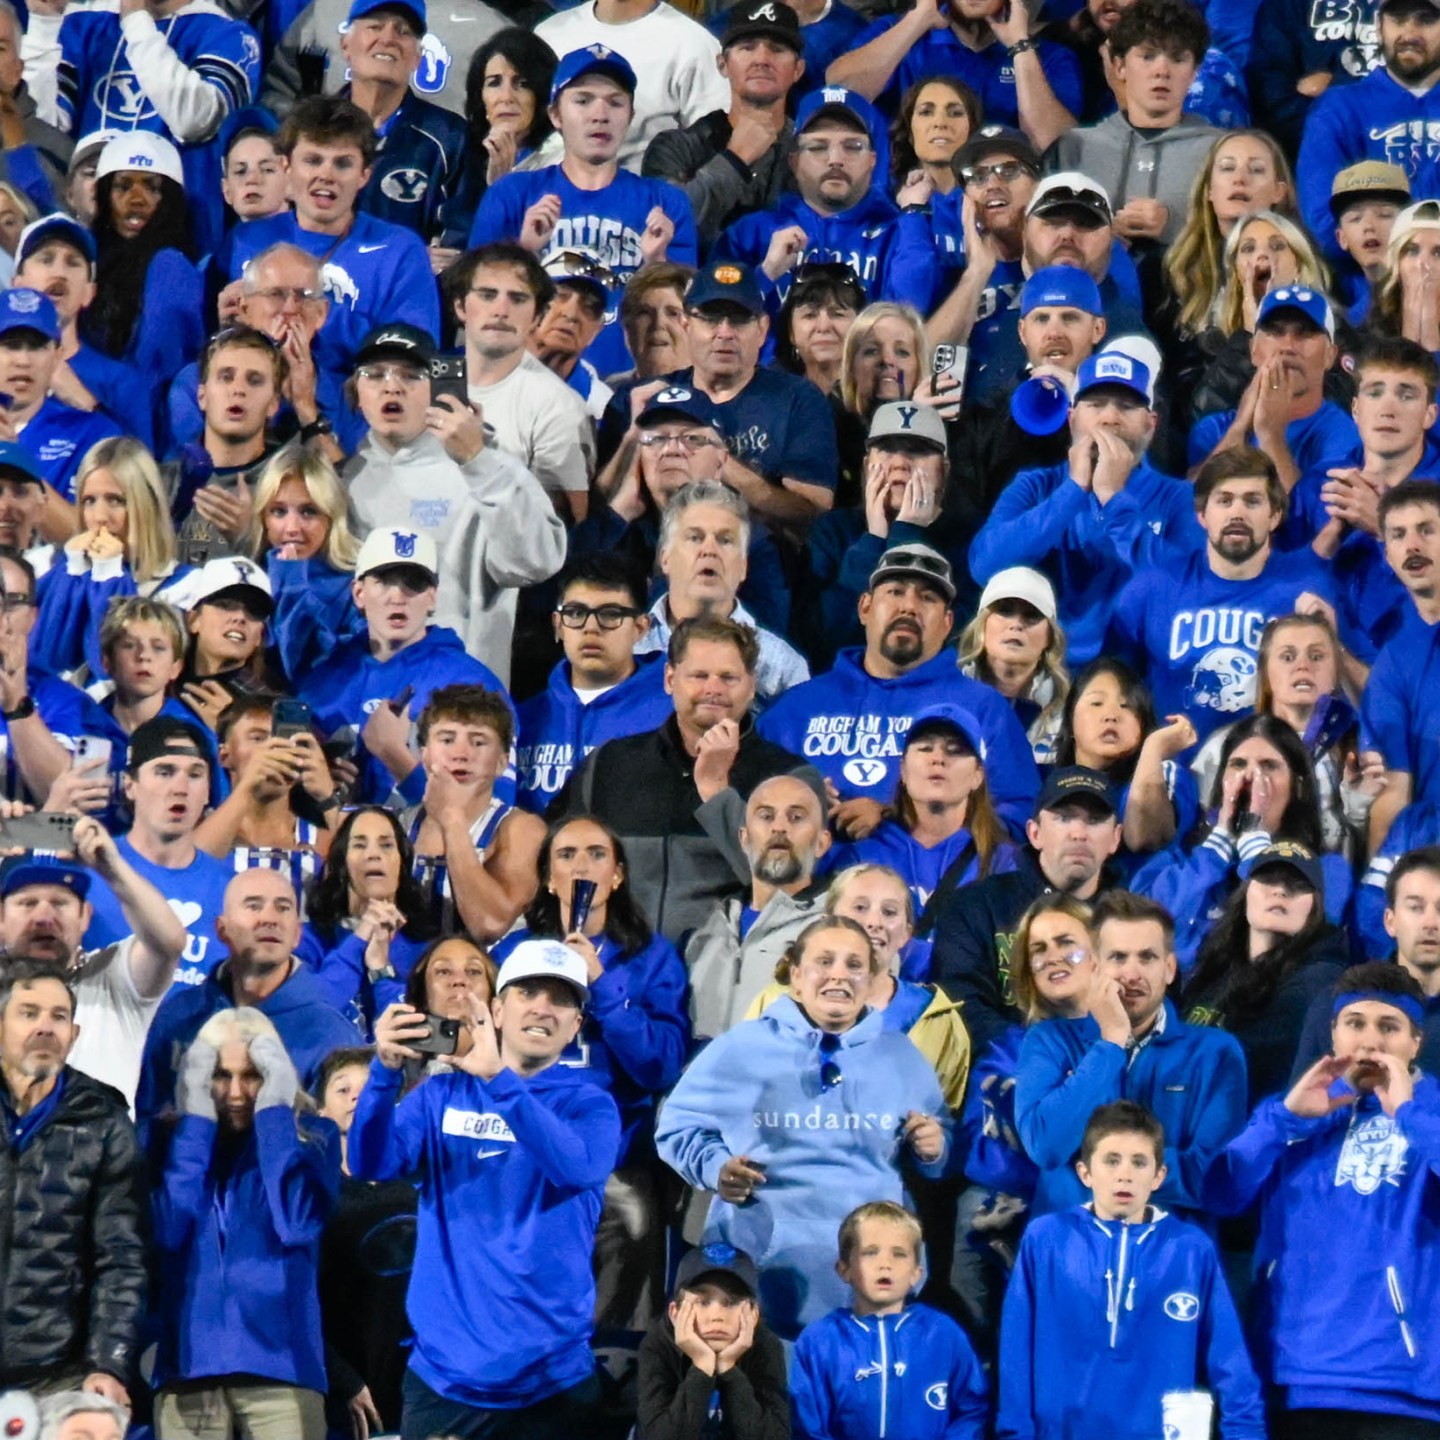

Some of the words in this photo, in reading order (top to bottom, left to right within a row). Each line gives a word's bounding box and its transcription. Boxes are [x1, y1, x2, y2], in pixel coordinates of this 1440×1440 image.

[748, 2, 776, 21] A
[545, 215, 644, 269] OUGS
[897, 406, 919, 430] Y
[1169, 608, 1276, 667] COUG
[803, 733, 903, 758] COUGA
[753, 1106, 893, 1133] sundance
[1171, 1295, 1197, 1318] Y
